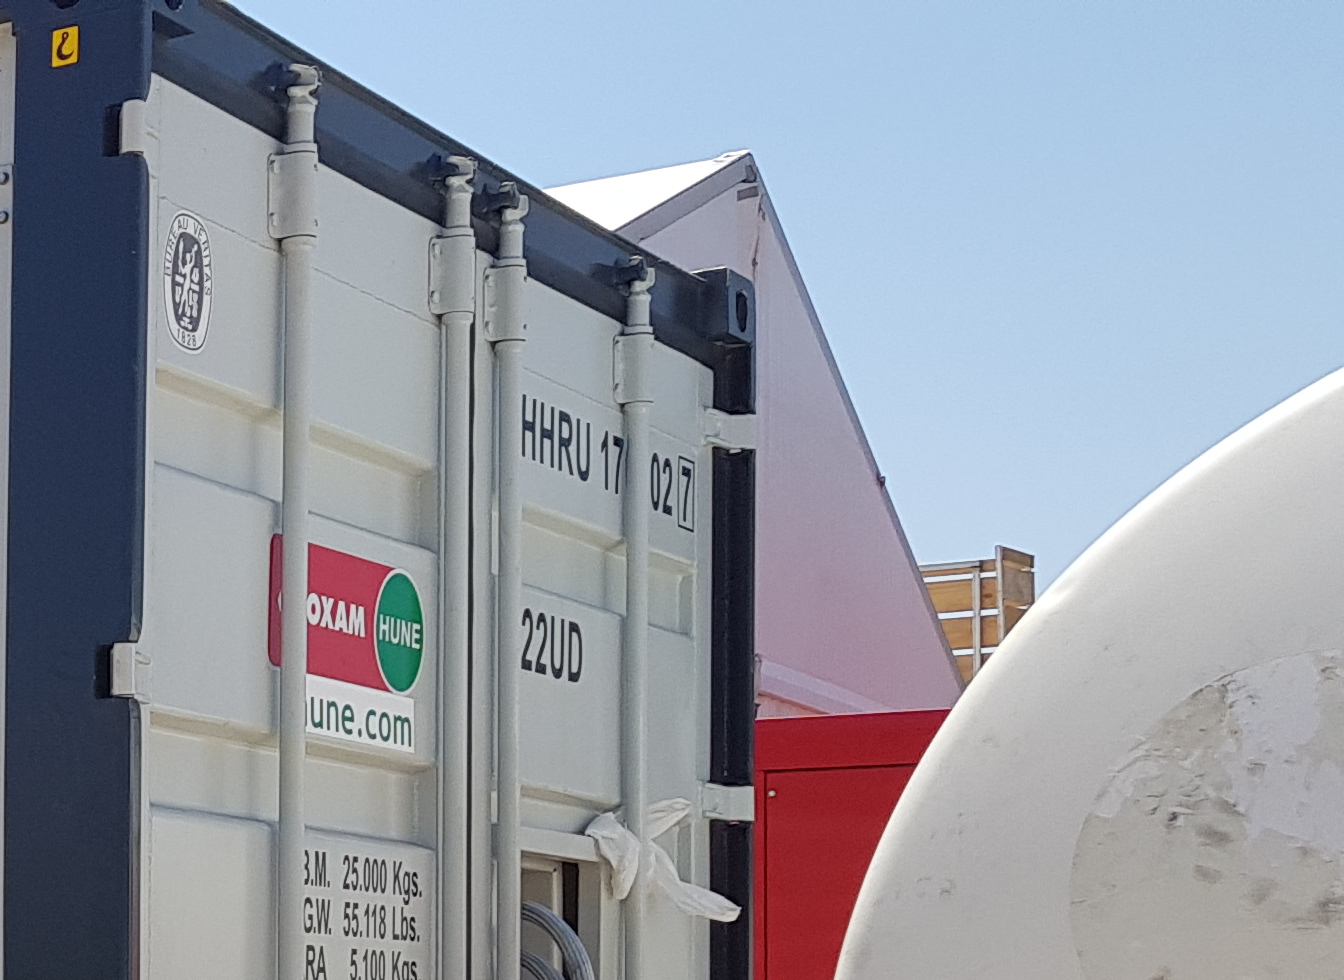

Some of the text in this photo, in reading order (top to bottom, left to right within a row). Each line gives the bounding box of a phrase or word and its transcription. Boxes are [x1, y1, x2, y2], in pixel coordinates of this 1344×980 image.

[521, 394, 693, 526] HHRU 1702 7
[306, 592, 421, 650] OXAM HUNE
[521, 608, 583, 683] 22UD
[305, 696, 412, 748] une.com
[342, 854, 388, 894] 25.000
[392, 860, 423, 905] Kgs.
[342, 901, 387, 939] 55.118
[392, 906, 420, 942] Lbs.
[305, 944, 327, 980] RA
